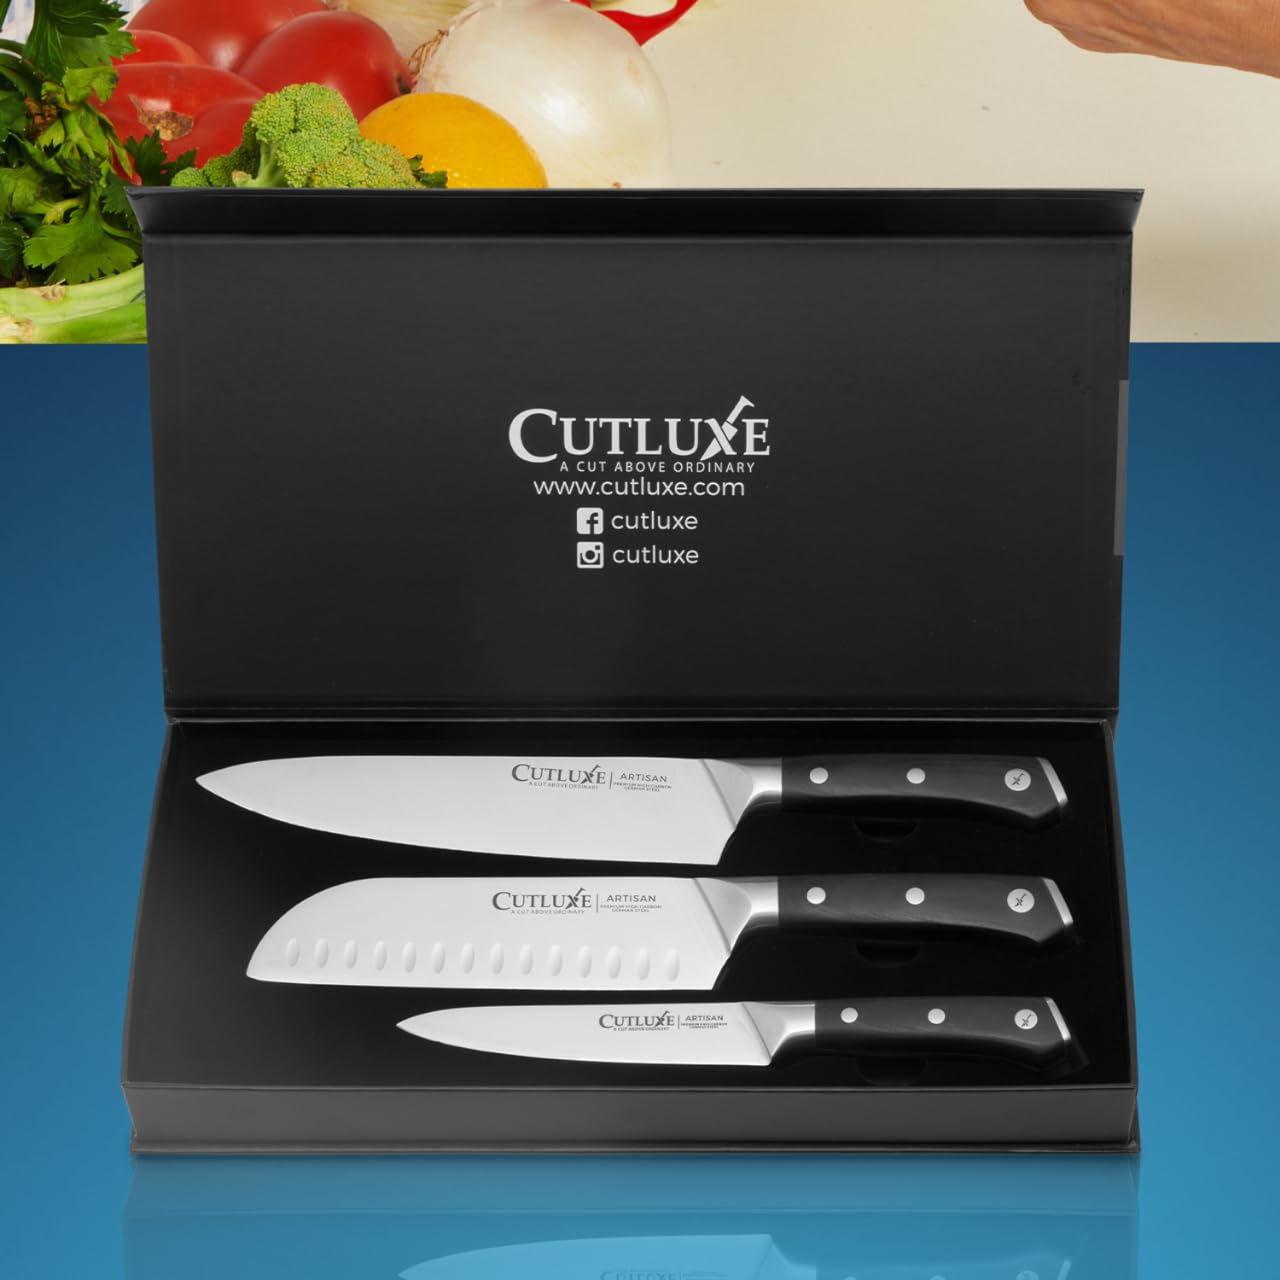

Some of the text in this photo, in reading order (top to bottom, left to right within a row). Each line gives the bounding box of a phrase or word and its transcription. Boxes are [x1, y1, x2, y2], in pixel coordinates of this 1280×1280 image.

[509, 396, 771, 463] CUTLUXE
[559, 461, 755, 473] A CUT ABOVE ORDINARY
[534, 476, 745, 497] www.cutluxe.com
[611, 510, 699, 530] cutluxe
[612, 544, 699, 564] cutluxe
[511, 763, 668, 785] CUTLUXE ARTISAN
[492, 887, 657, 911] CUTLUXE ARTISAN
[598, 1010, 675, 1029] CUTLUXE
